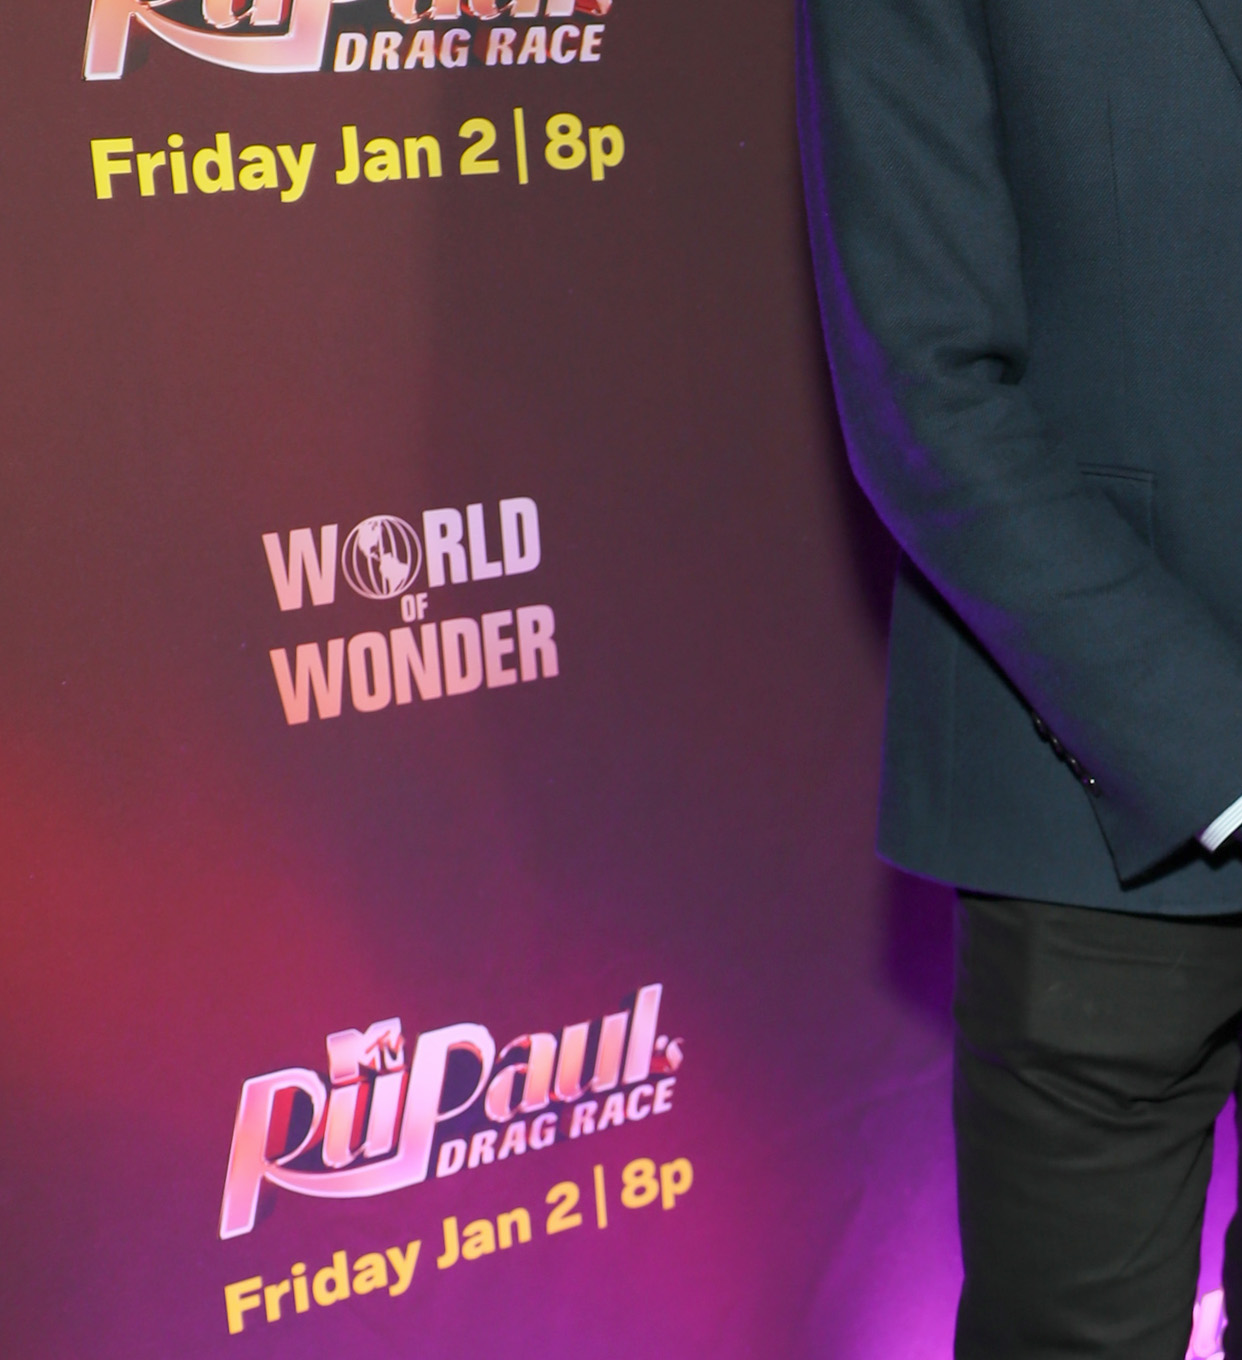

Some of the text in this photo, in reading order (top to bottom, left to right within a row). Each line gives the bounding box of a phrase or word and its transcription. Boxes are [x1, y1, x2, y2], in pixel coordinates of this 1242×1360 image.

[332, 23, 606, 73] DRAG RACE
[90, 132, 317, 203] Friday
[335, 125, 443, 187] Jan
[458, 116, 501, 176] 2
[544, 112, 626, 182] 8p
[262, 496, 542, 612] WORLD
[401, 592, 428, 623] OF
[269, 604, 559, 726] WONDER
[326, 1017, 406, 1085] MTV
[219, 983, 685, 1240] RuPaul's
[436, 1076, 677, 1178] DRAG RACE
[223, 1238, 422, 1335] Friday
[436, 1206, 533, 1271] Jan
[545, 1180, 583, 1236] 2
[621, 1156, 694, 1211] 8p
